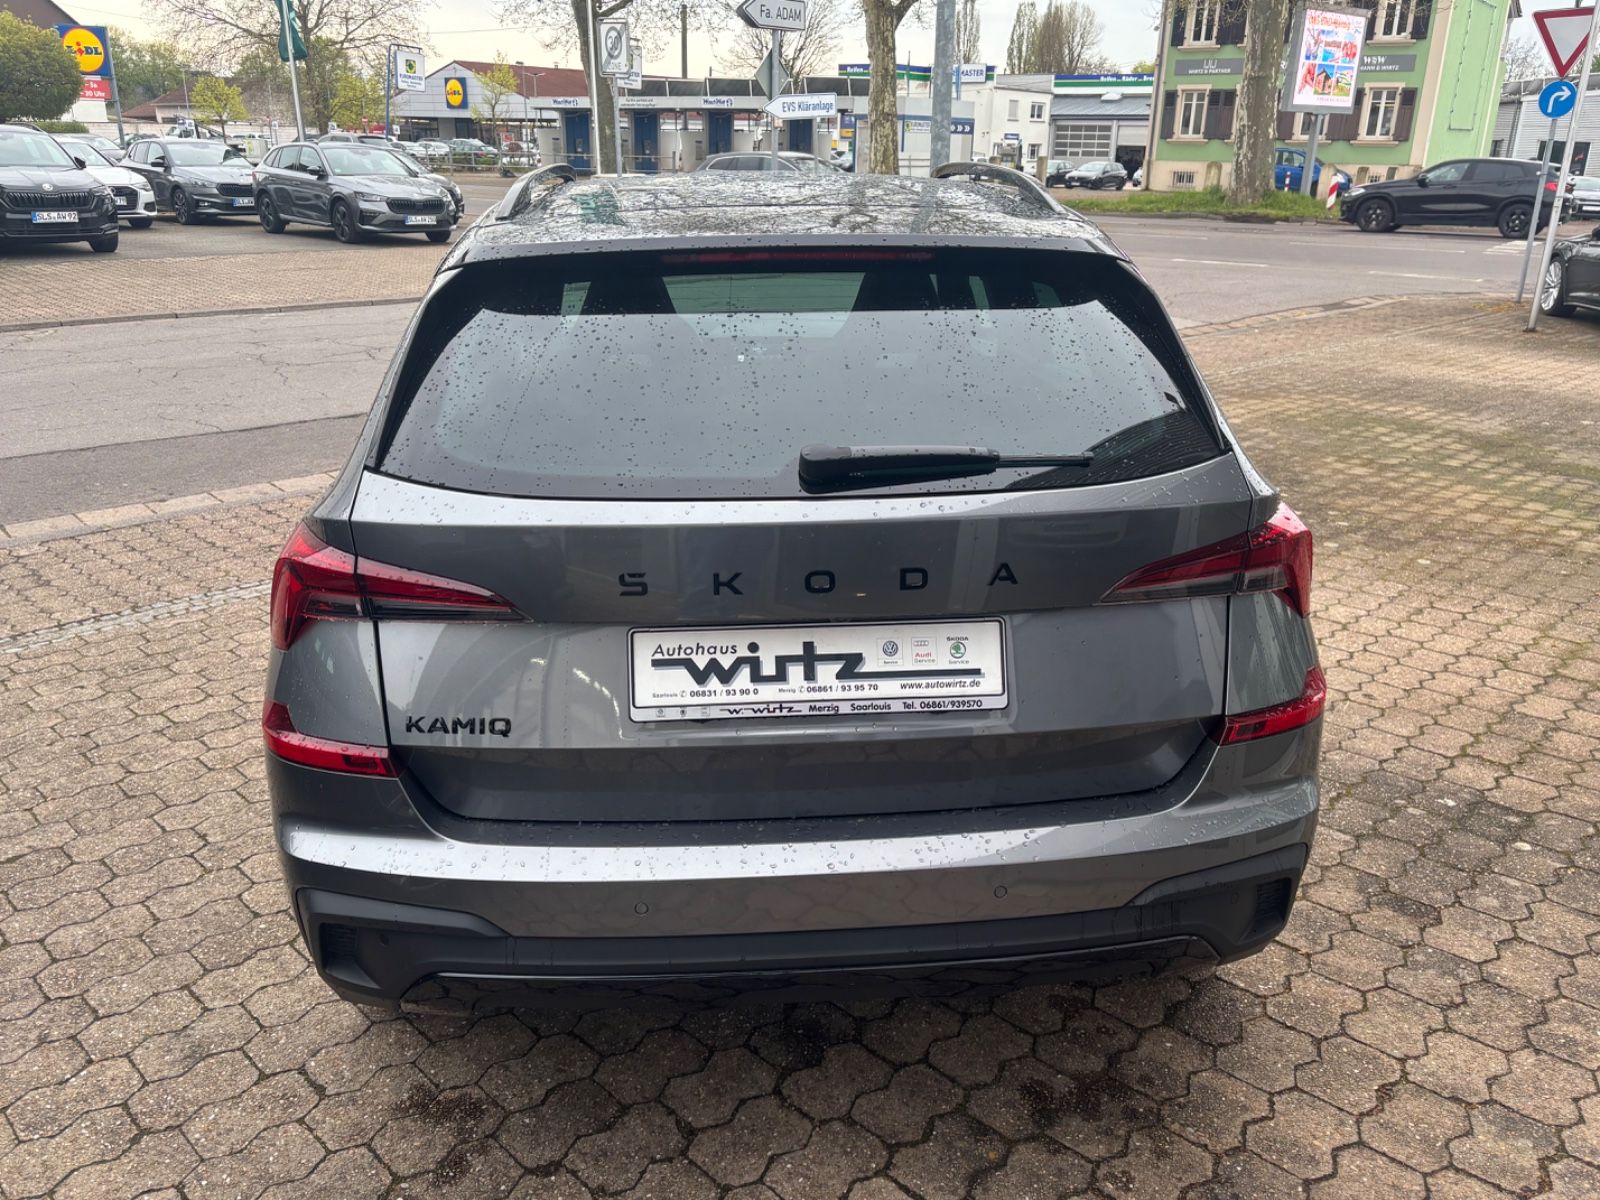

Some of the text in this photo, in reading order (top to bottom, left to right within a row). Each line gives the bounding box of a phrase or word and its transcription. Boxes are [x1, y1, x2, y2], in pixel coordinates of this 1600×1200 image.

[760, 4, 802, 22] Fa. ADAM
[608, 35, 619, 51] 30
[782, 100, 833, 113] EVS Kläranlage
[651, 642, 738, 657] Autohaus
[806, 684, 833, 694] 06861
[841, 684, 852, 692] 93
[900, 679, 981, 690] www.autowirtz.de
[690, 690, 717, 698] 06831
[725, 689, 737, 697] 93
[808, 704, 840, 714] Merzig
[850, 702, 892, 712] Saarlouis
[902, 702, 916, 710] Tel.
[920, 700, 983, 710] 06861/939570
[405, 716, 512, 738] KAMIQ
